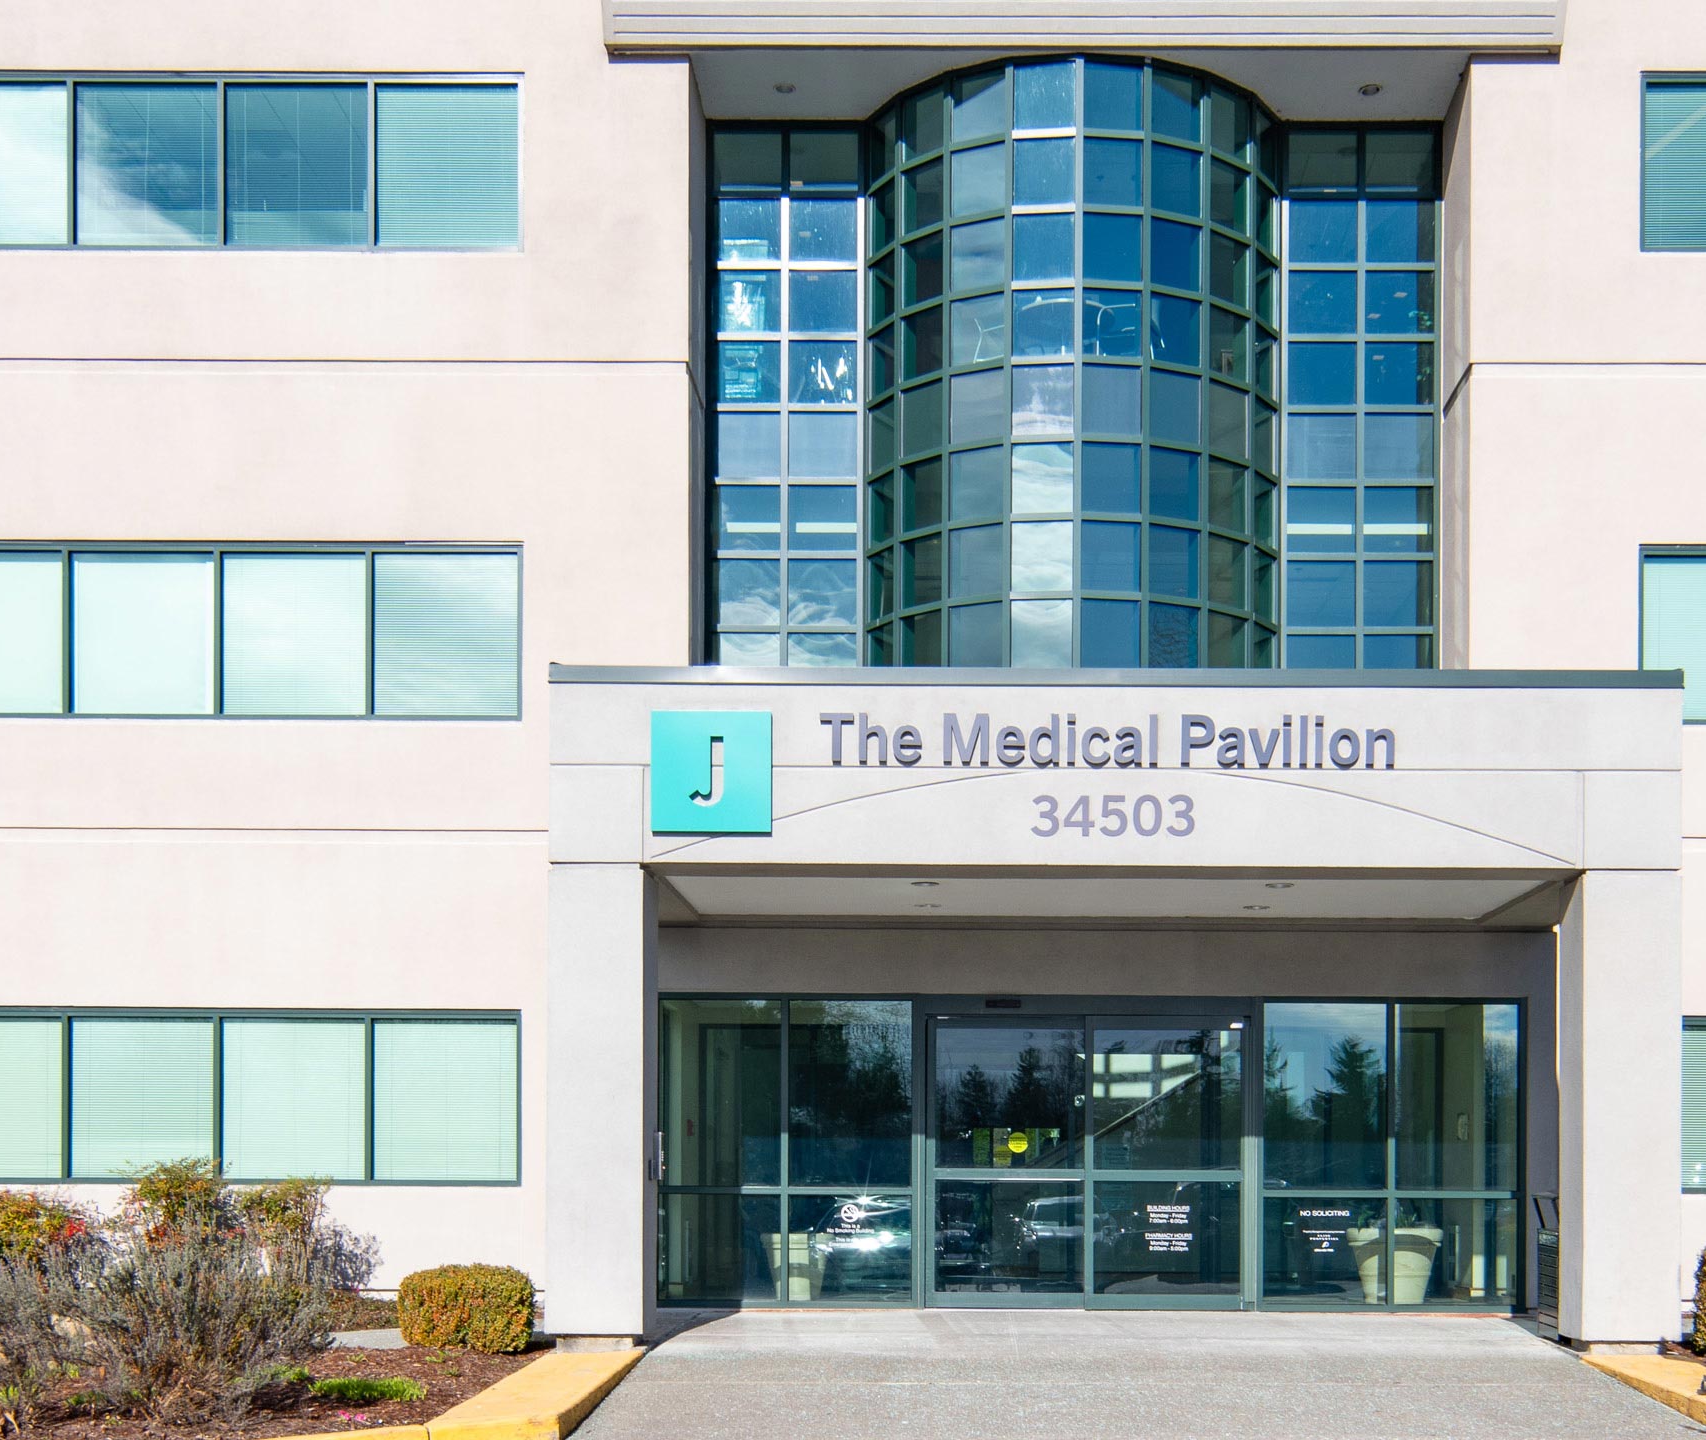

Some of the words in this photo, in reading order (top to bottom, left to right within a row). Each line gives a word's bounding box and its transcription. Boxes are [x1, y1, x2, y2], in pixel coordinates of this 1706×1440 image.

[819, 712, 923, 767] The
[943, 713, 1159, 769] Medical
[1180, 714, 1396, 770] Pavilion
[688, 735, 725, 808] J
[1030, 794, 1196, 837] 34503
